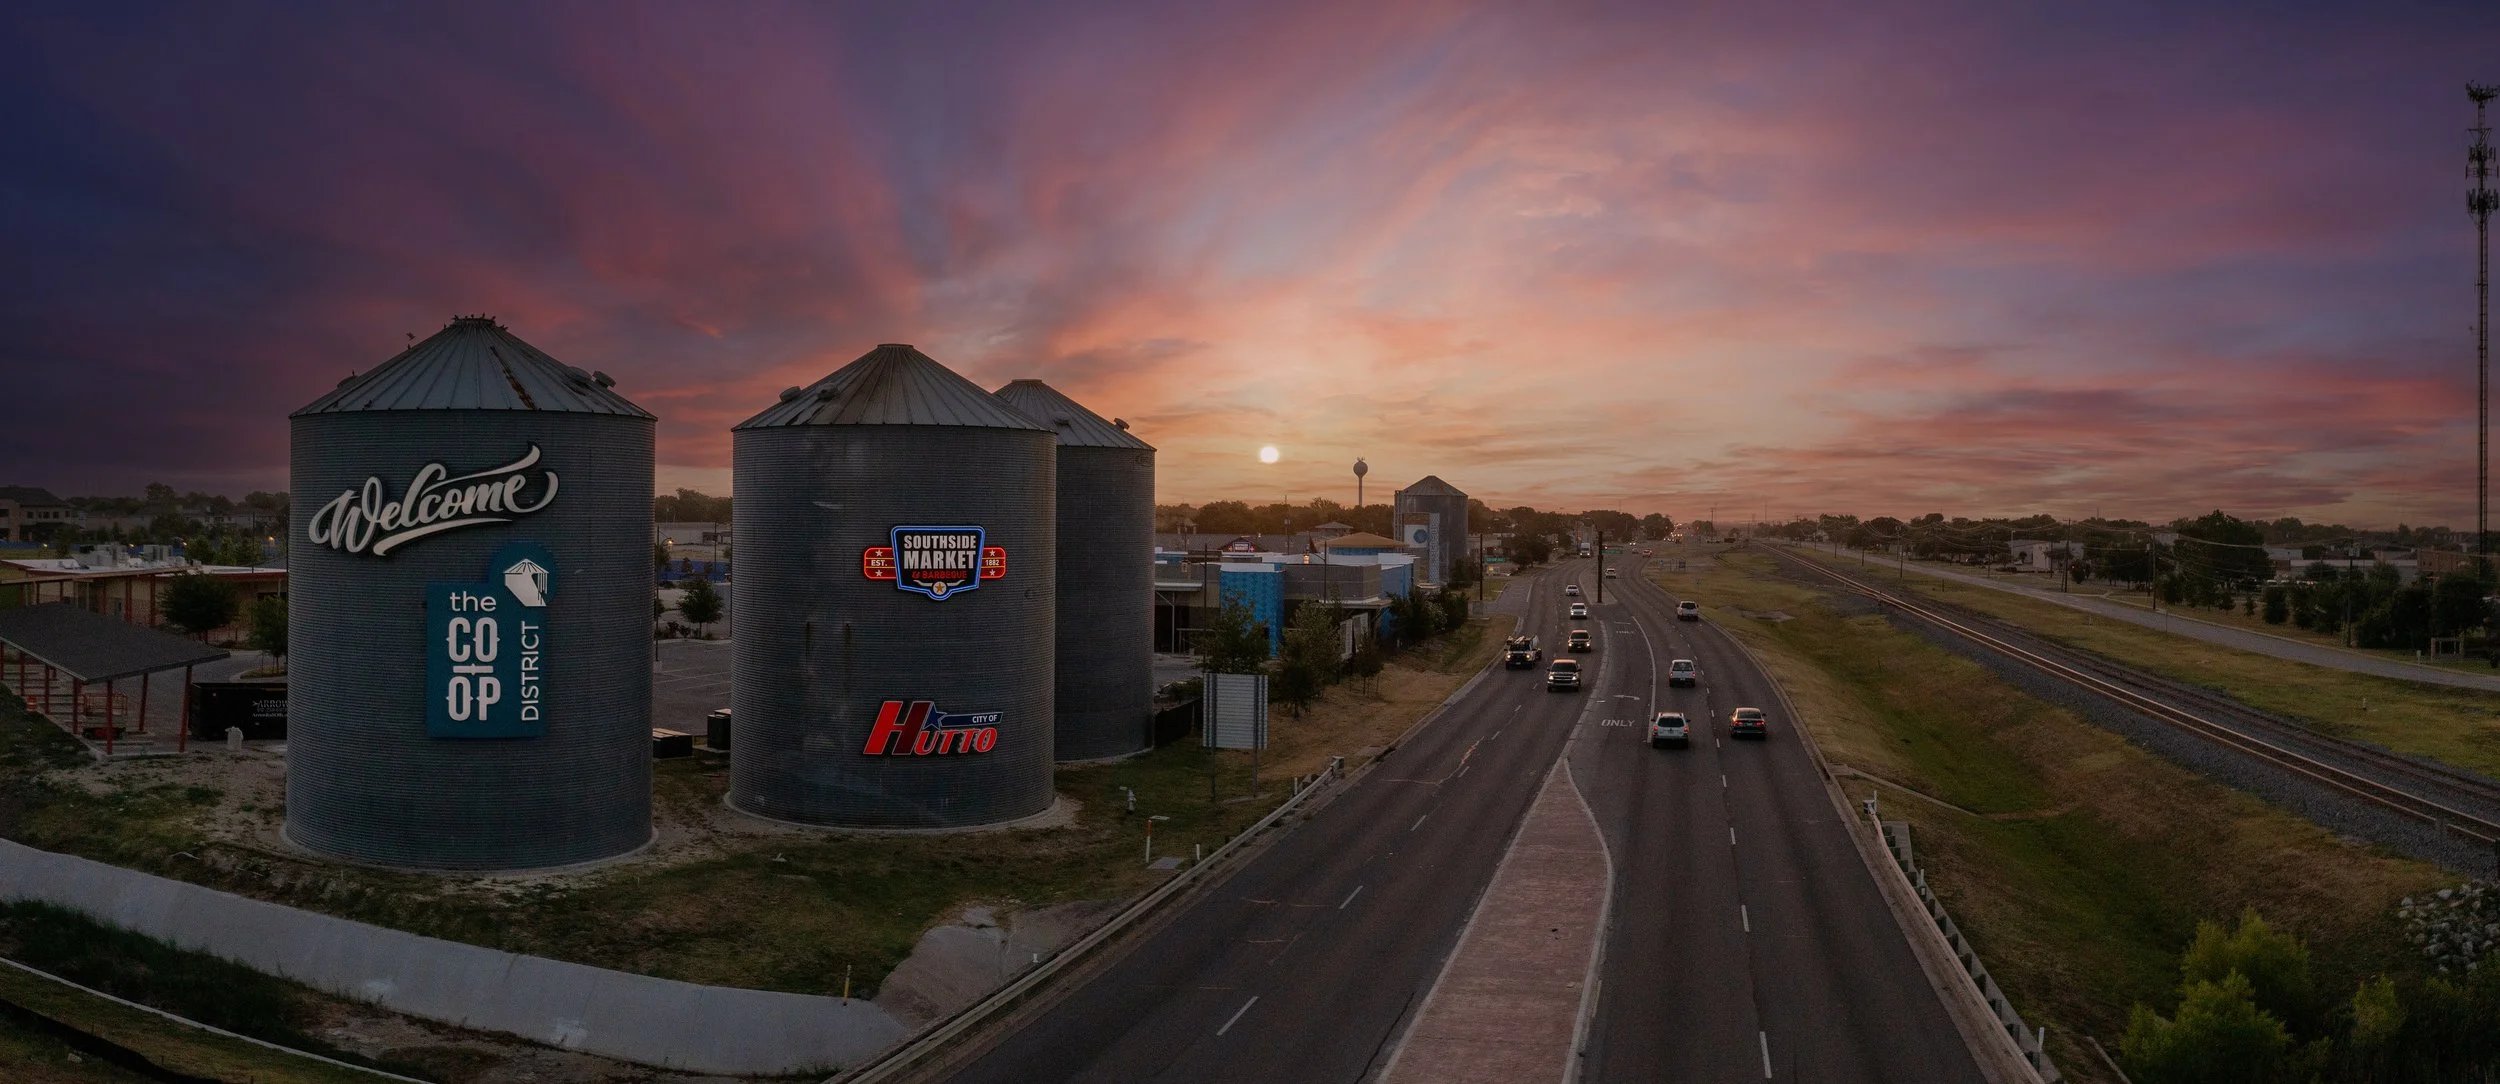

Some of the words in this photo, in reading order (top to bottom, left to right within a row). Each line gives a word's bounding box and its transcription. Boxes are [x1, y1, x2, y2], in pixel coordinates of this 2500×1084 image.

[309, 445, 559, 556] Welcome
[904, 535, 976, 549] SOUTHSIDE
[871, 559, 888, 567] EST.
[904, 551, 976, 569] MARKET
[922, 571, 967, 579] BARBEQUE
[450, 591, 497, 612] the
[521, 621, 540, 721] DISTRICT
[972, 715, 988, 724] CITY
[989, 714, 998, 722] OF
[1601, 719, 1635, 728] ONLY
